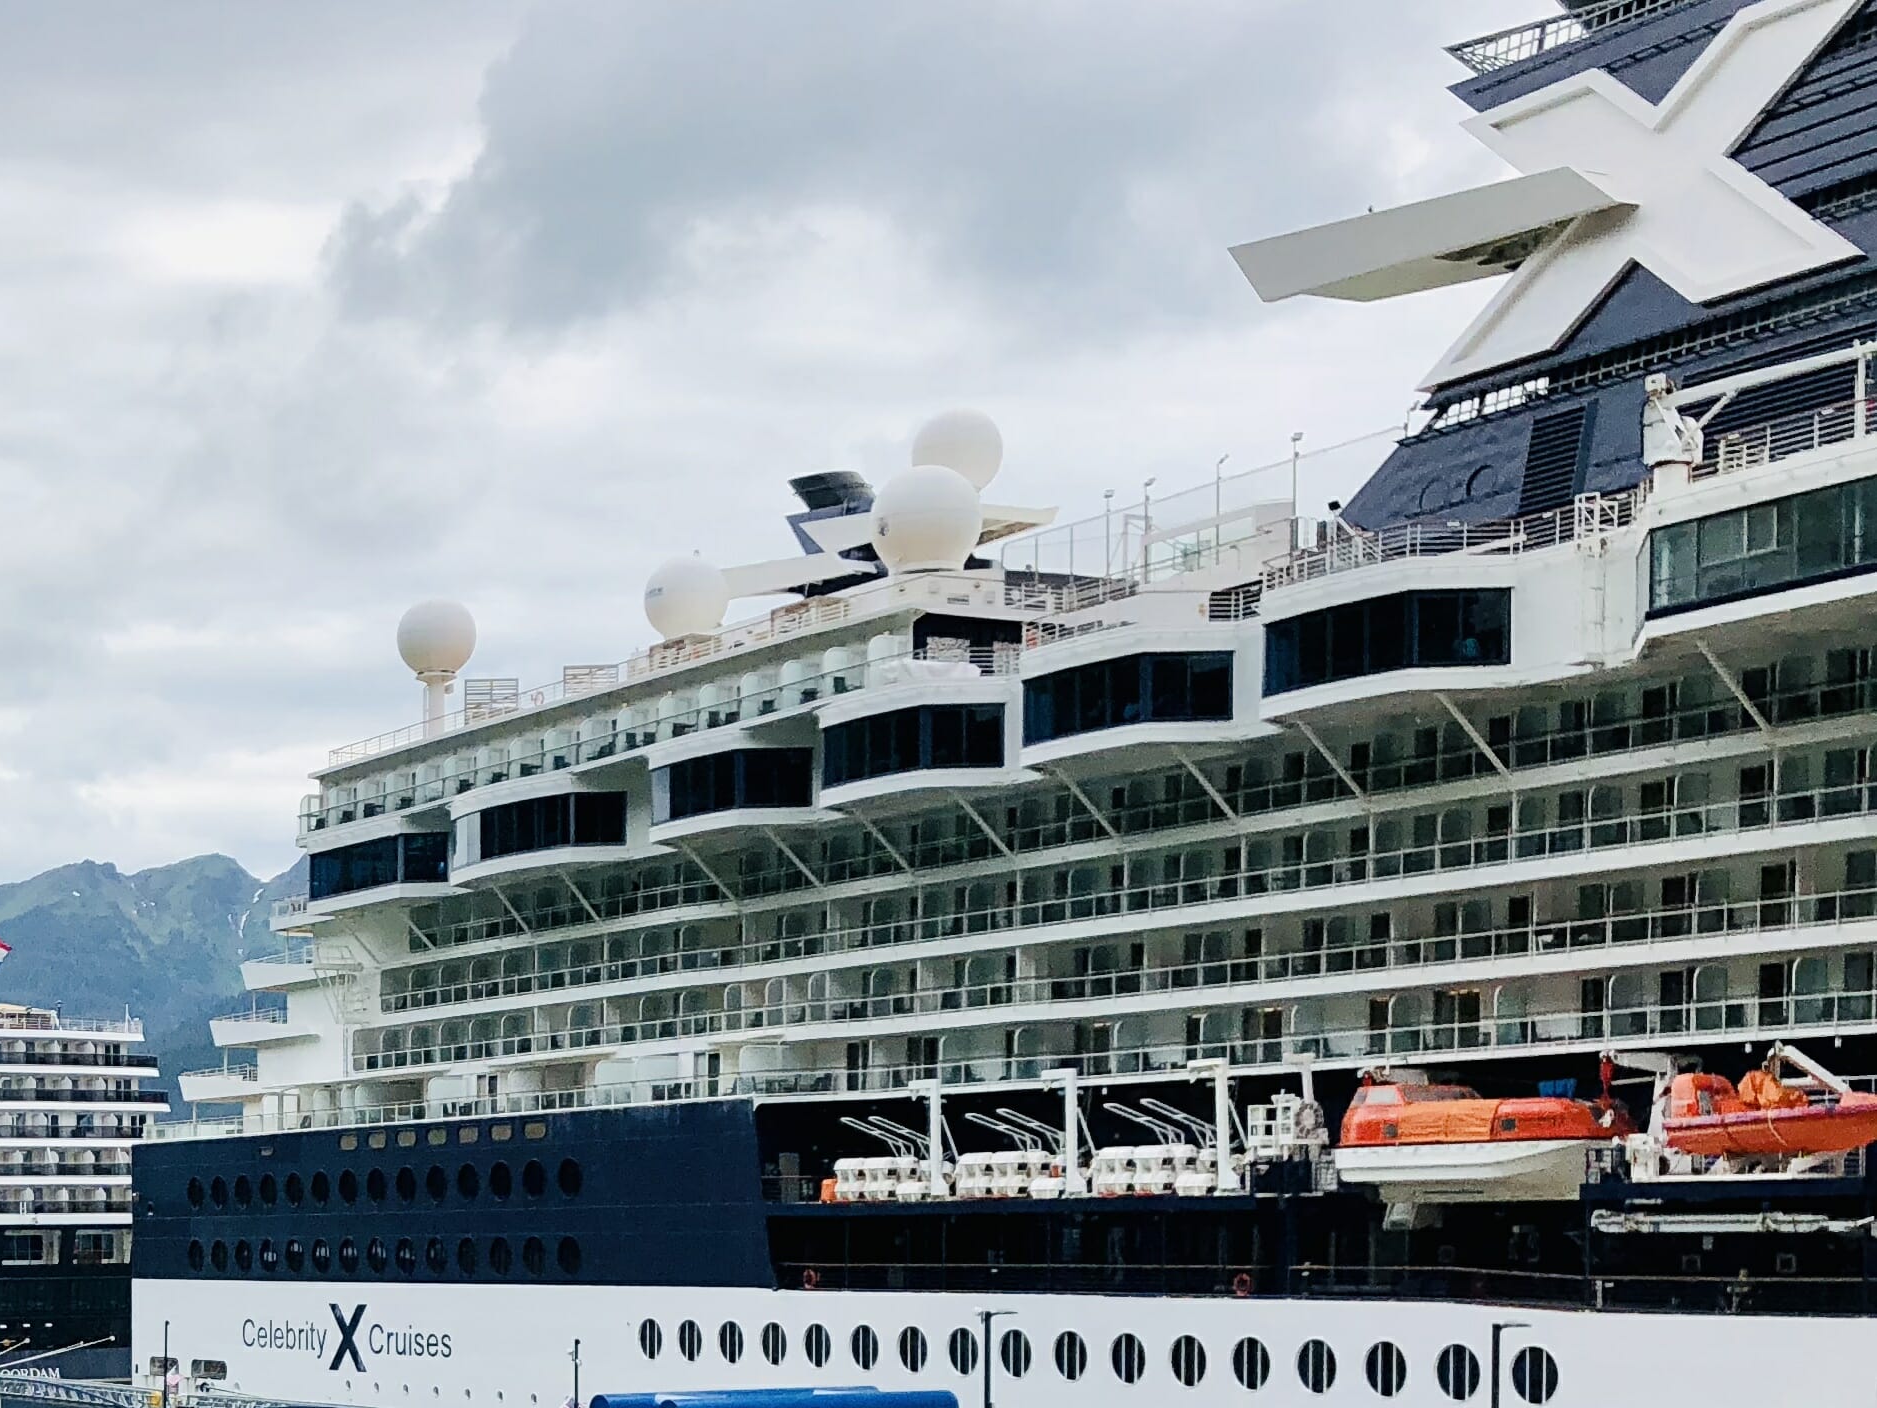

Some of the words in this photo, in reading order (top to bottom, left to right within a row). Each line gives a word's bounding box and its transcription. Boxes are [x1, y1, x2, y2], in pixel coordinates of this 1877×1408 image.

[242, 1318, 328, 1359] Celebrity
[329, 1303, 368, 1372] X
[369, 1323, 452, 1358] Cruises
